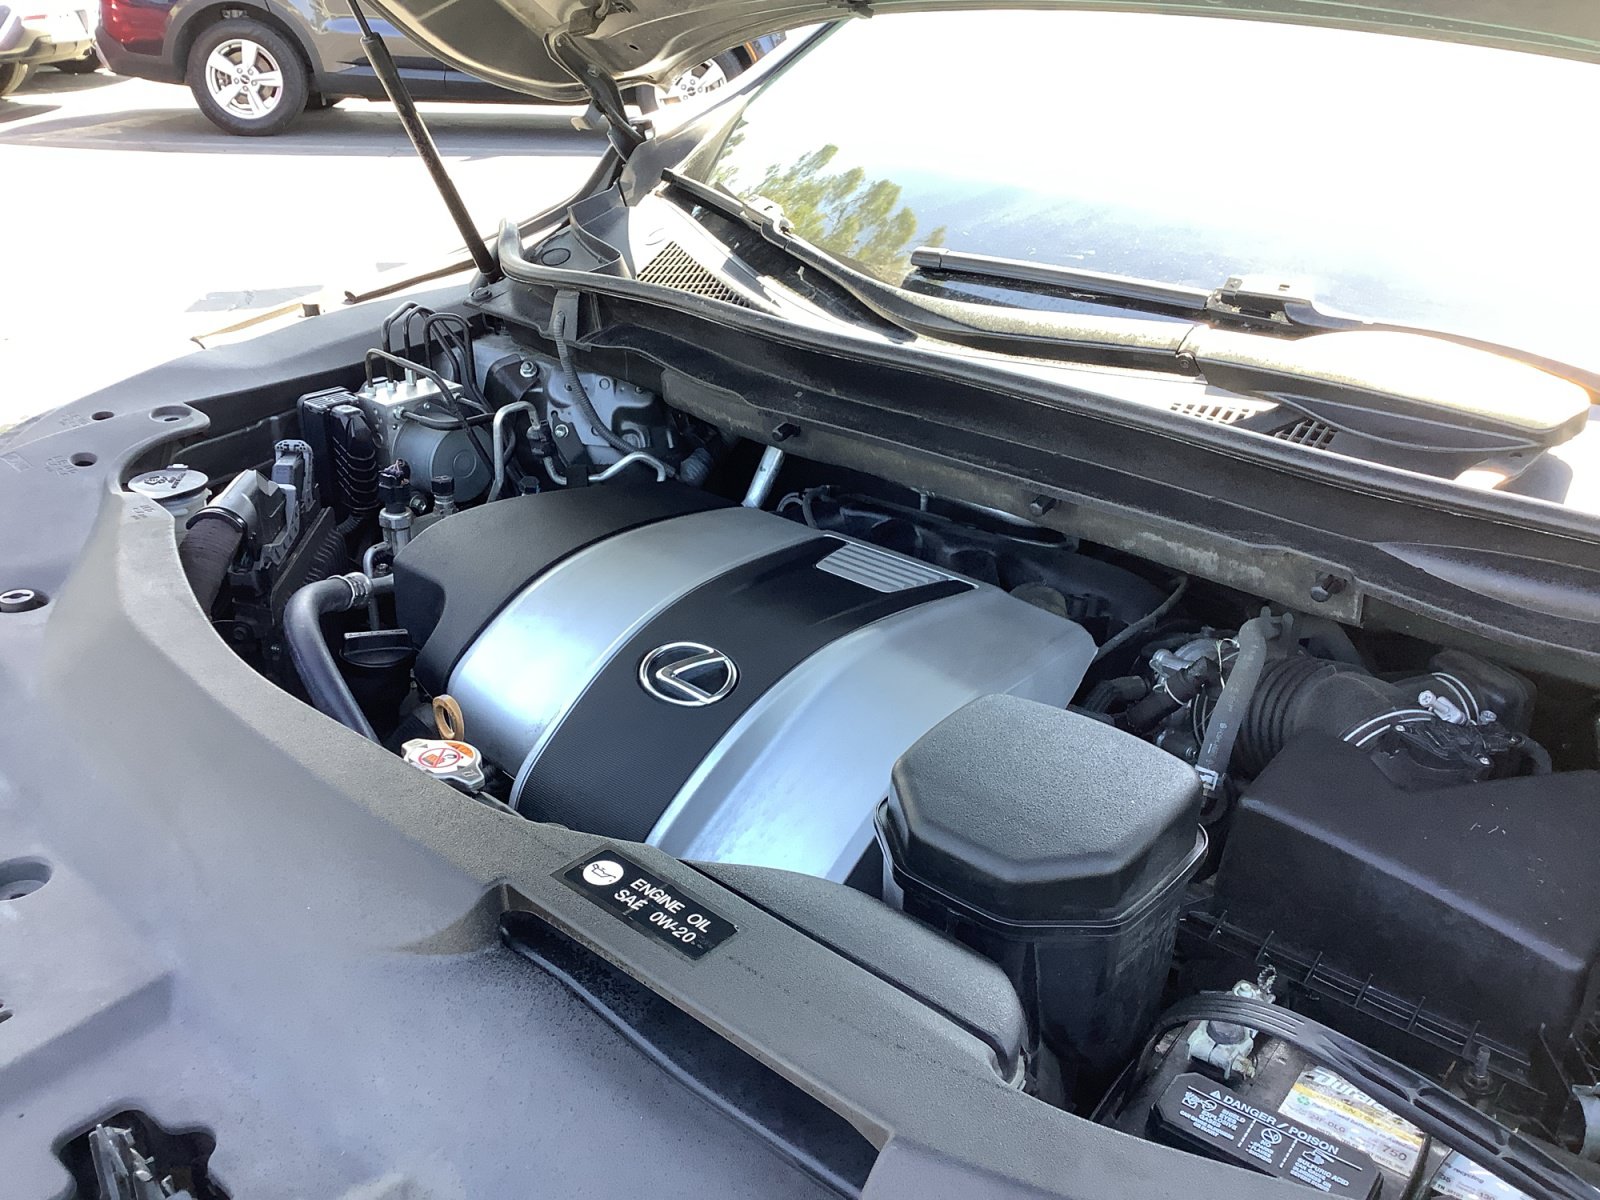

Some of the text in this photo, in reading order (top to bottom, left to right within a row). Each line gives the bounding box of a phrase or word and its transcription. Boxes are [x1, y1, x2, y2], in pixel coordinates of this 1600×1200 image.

[614, 889, 697, 943] SAE 0W-20
[630, 878, 713, 933] ENGINE OIL
[1223, 1095, 1277, 1125] DANGER
[1288, 1126, 1340, 1155] POISON
[1380, 1144, 1408, 1161] 750
[1330, 1174, 1349, 1186] ACID
